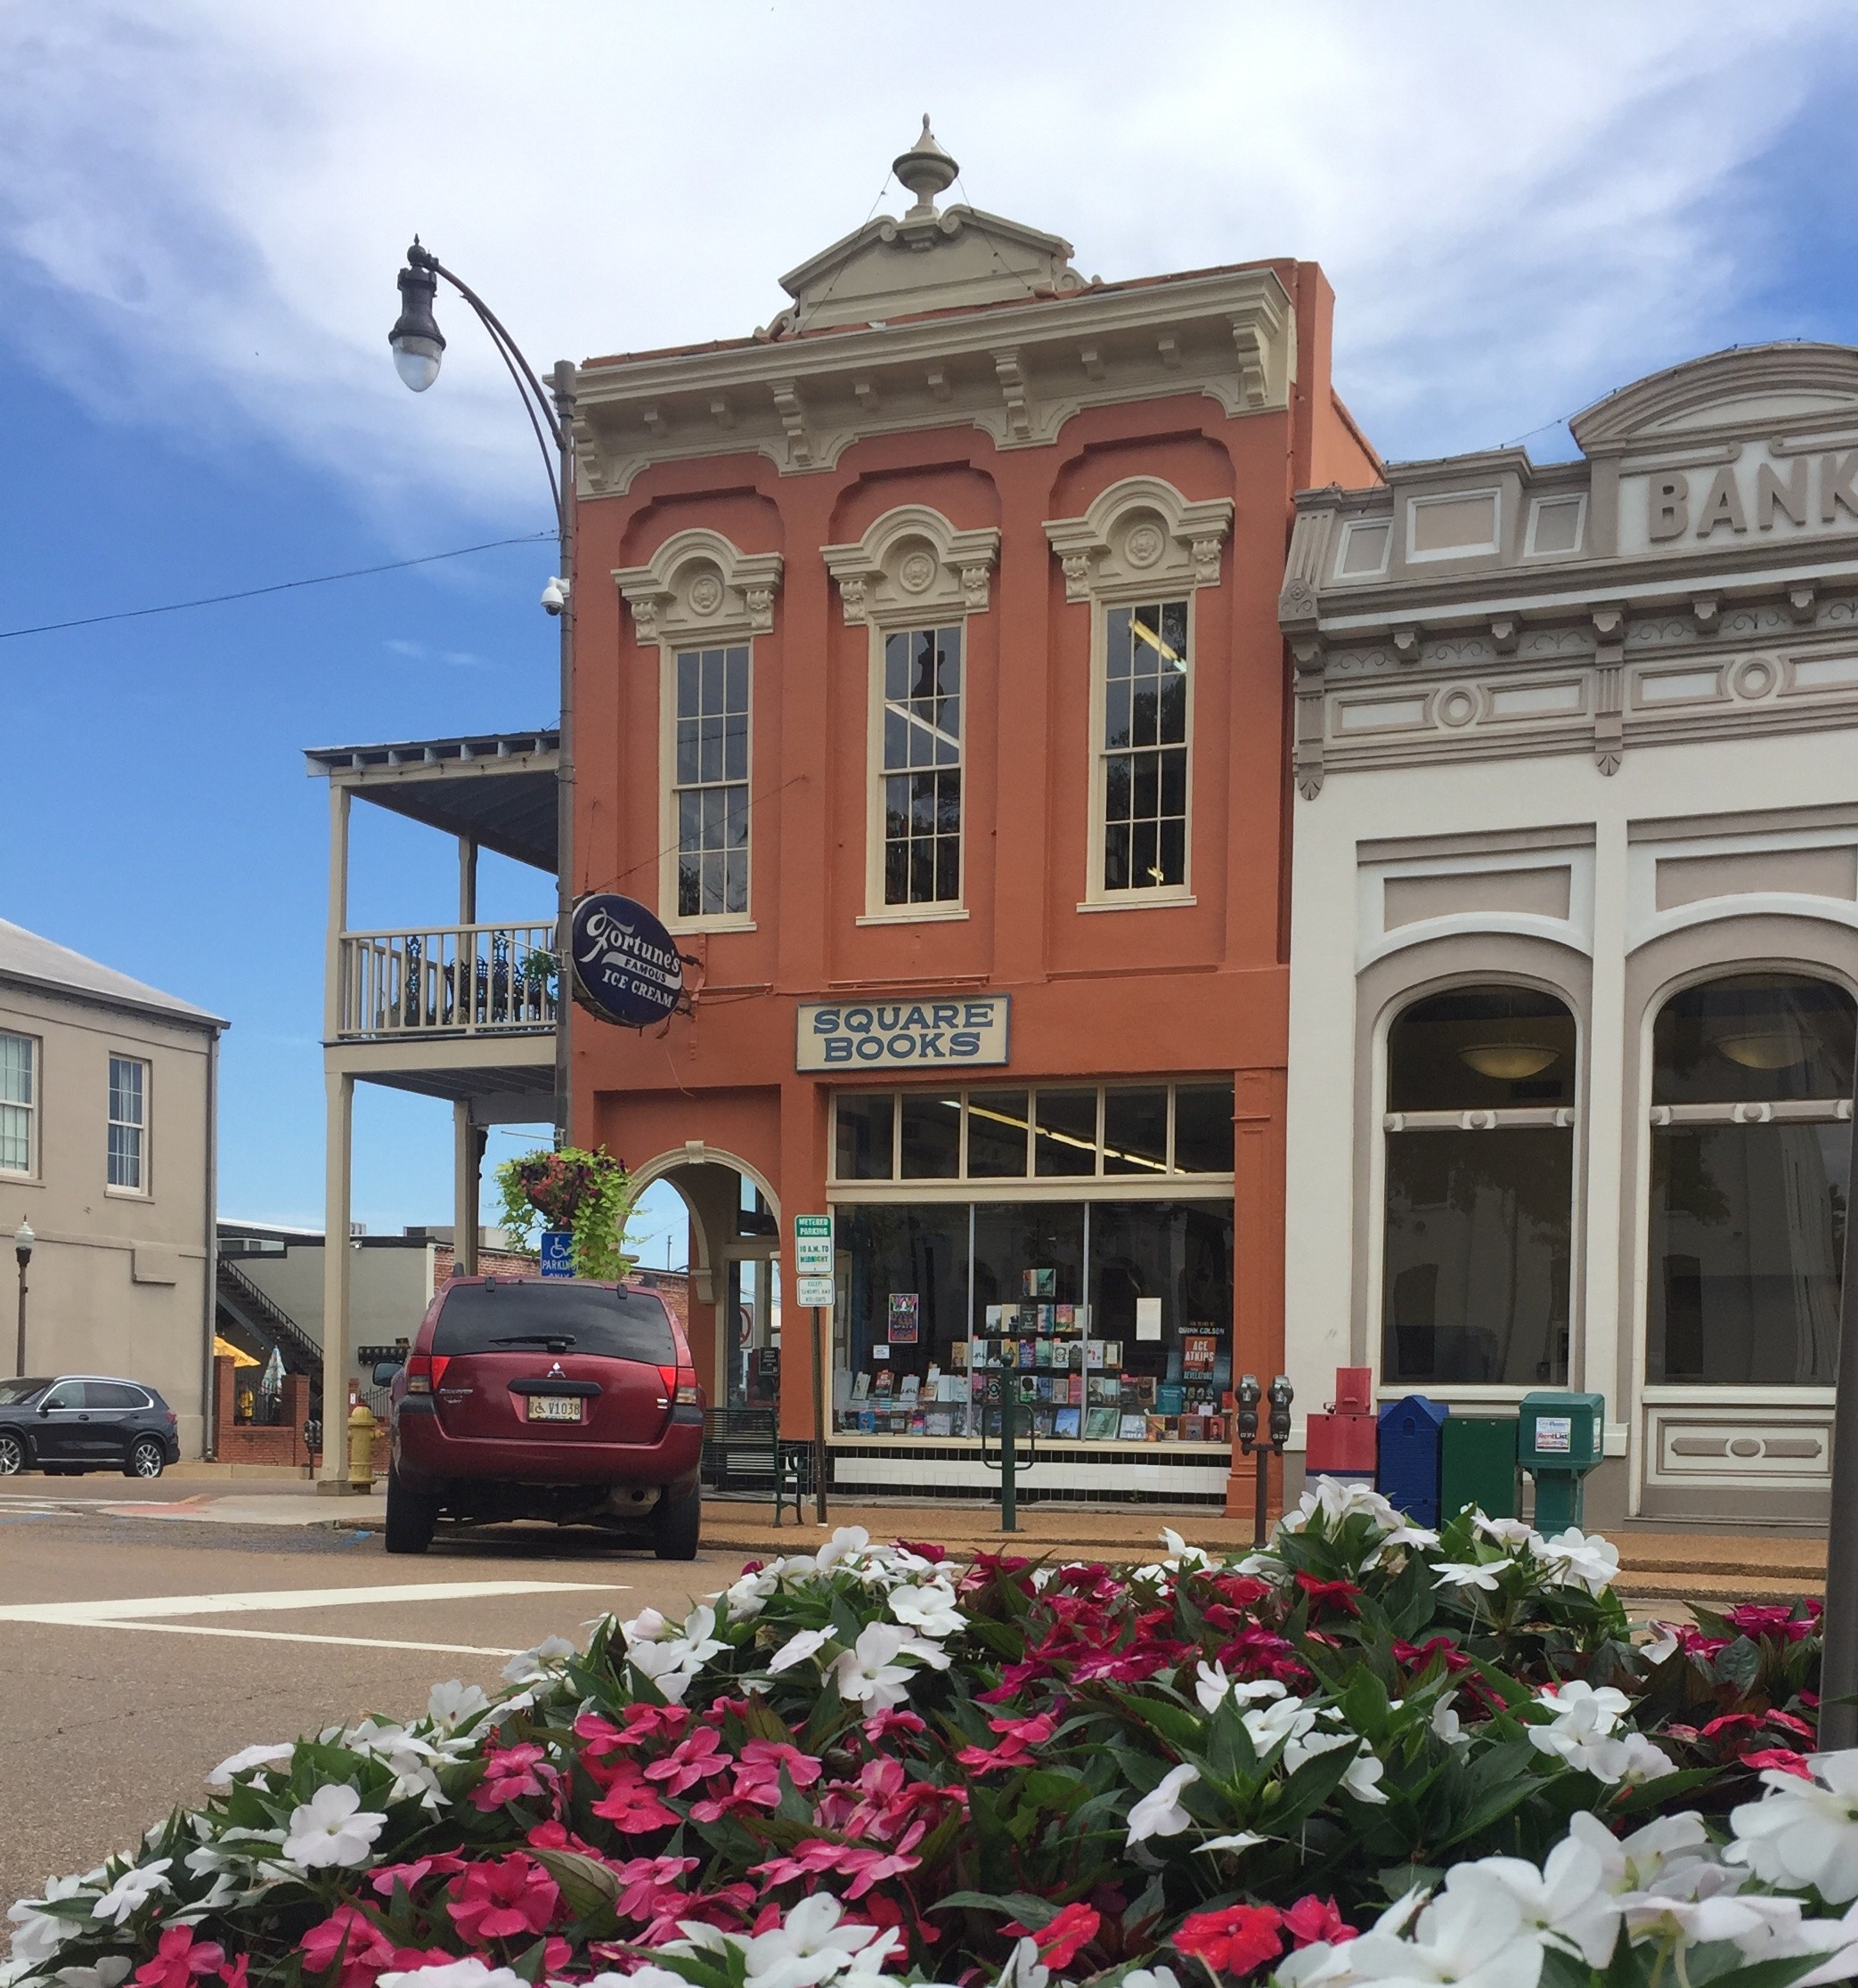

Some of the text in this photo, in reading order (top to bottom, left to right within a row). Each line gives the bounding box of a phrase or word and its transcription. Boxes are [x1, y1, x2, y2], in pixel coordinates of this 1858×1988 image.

[1650, 450, 1858, 542] BANK
[579, 907, 680, 973] Fortune's
[624, 958, 667, 983] FAMOUS
[601, 969, 673, 1008] ICE CREAM
[813, 1003, 994, 1035] SQUARE
[823, 1032, 981, 1063] BOOKS
[799, 1218, 828, 1226] METERED
[800, 1227, 828, 1235] PARKING
[1185, 1350, 1215, 1362] ATKINS
[1192, 1340, 1209, 1351] ACE
[549, 1402, 581, 1415] V1038
